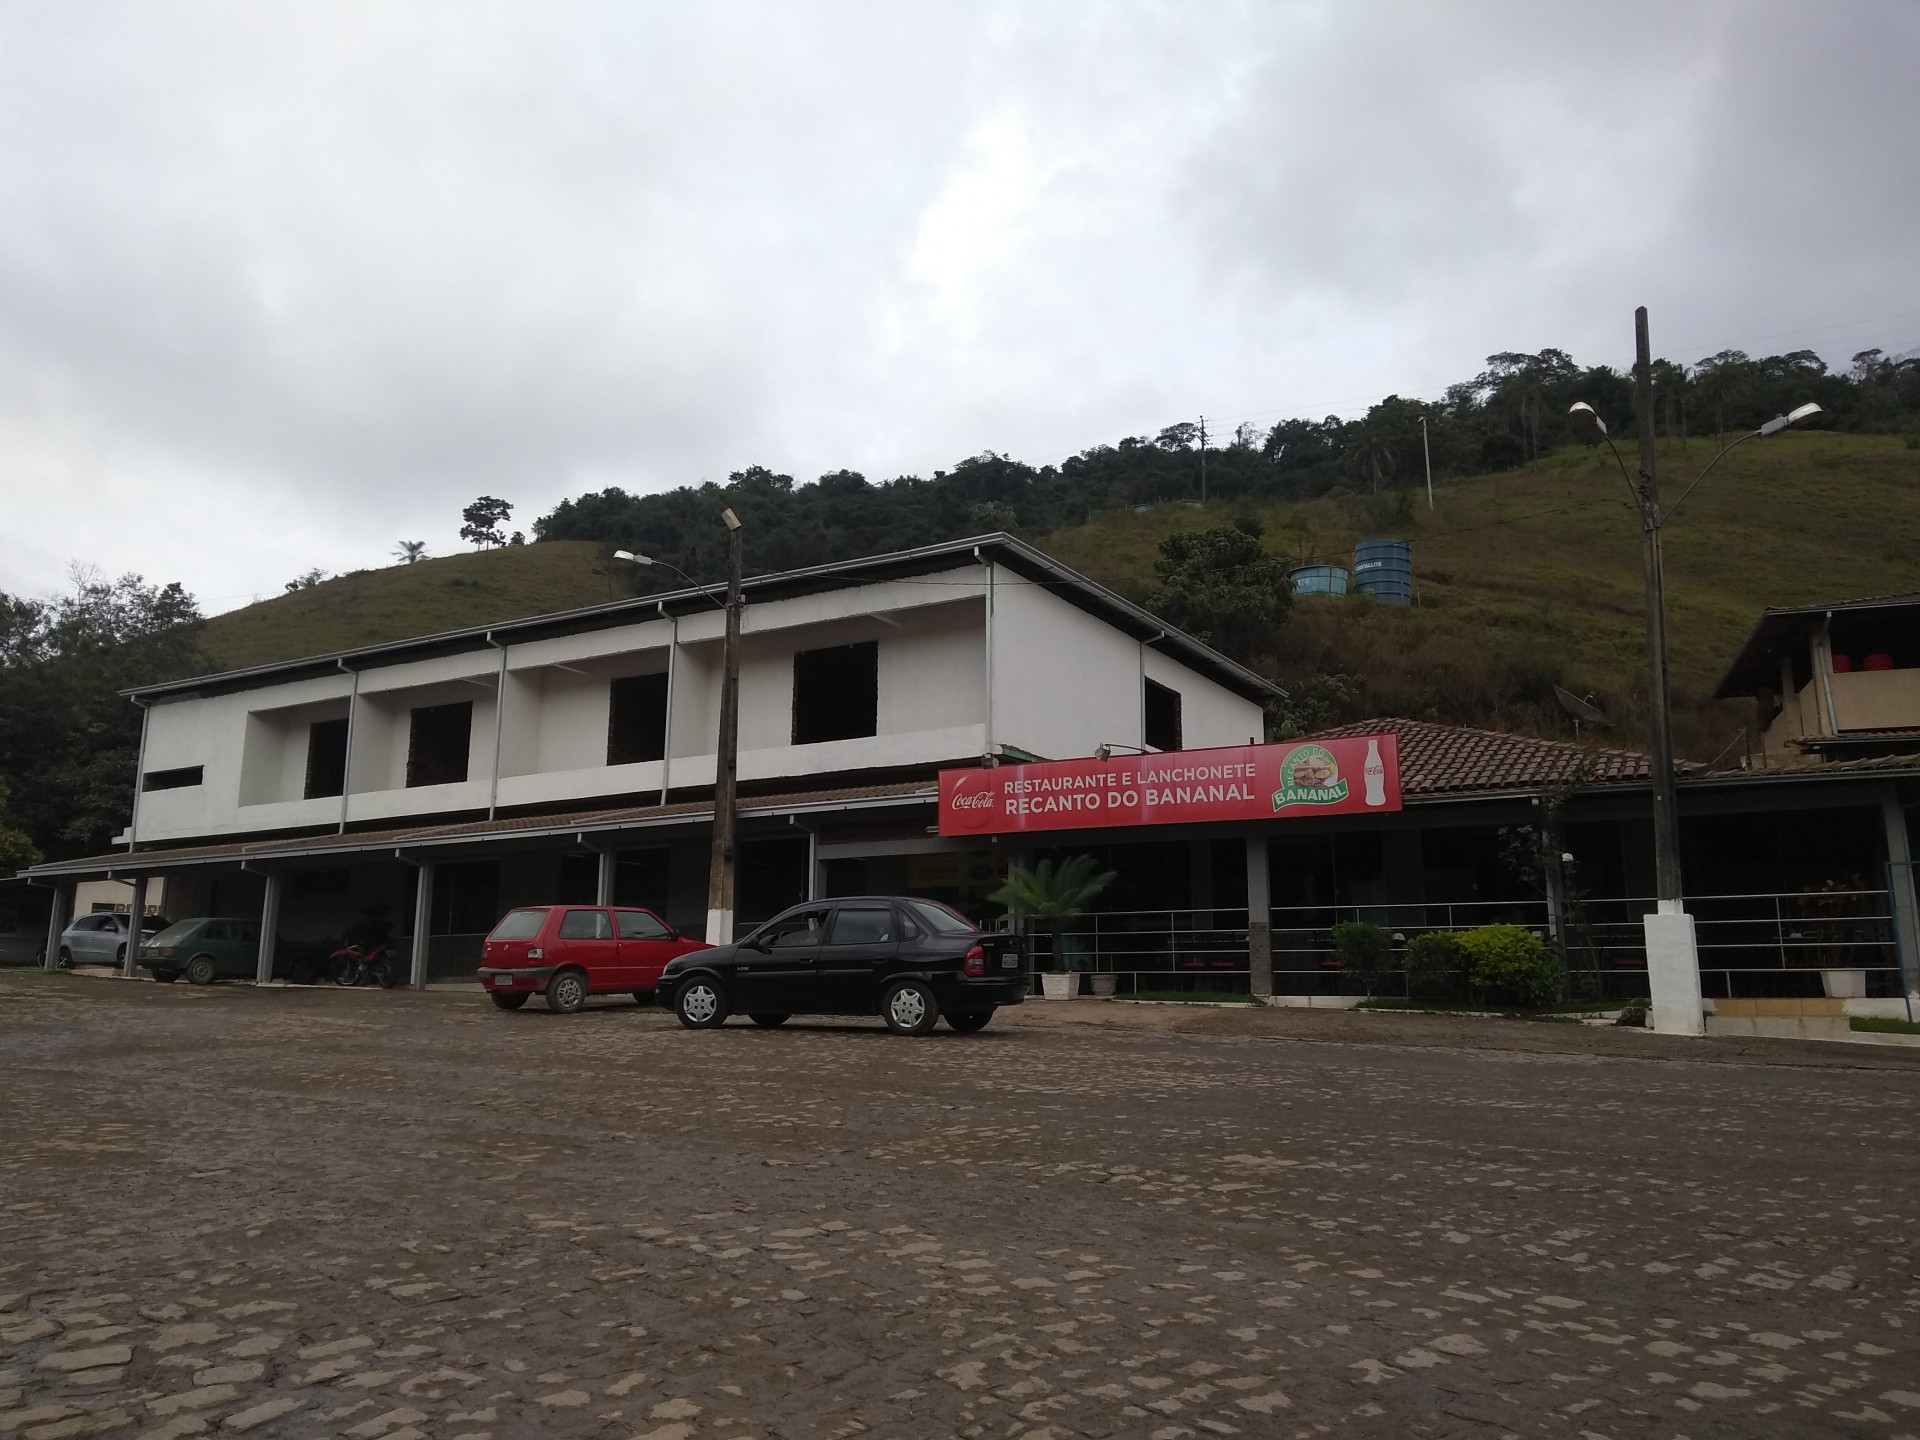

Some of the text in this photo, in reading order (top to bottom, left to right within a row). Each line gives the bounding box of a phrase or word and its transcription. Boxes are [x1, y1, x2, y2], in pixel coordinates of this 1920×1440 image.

[1004, 763, 1256, 794] RESTAURANTE E LANCHONETE
[1287, 749, 1309, 786] RECANTO
[1313, 747, 1325, 756] DO
[952, 791, 995, 810] Coca-Cola
[1005, 783, 1256, 815] RECANTO DO BANANAL
[1274, 786, 1347, 805] BANANAL
